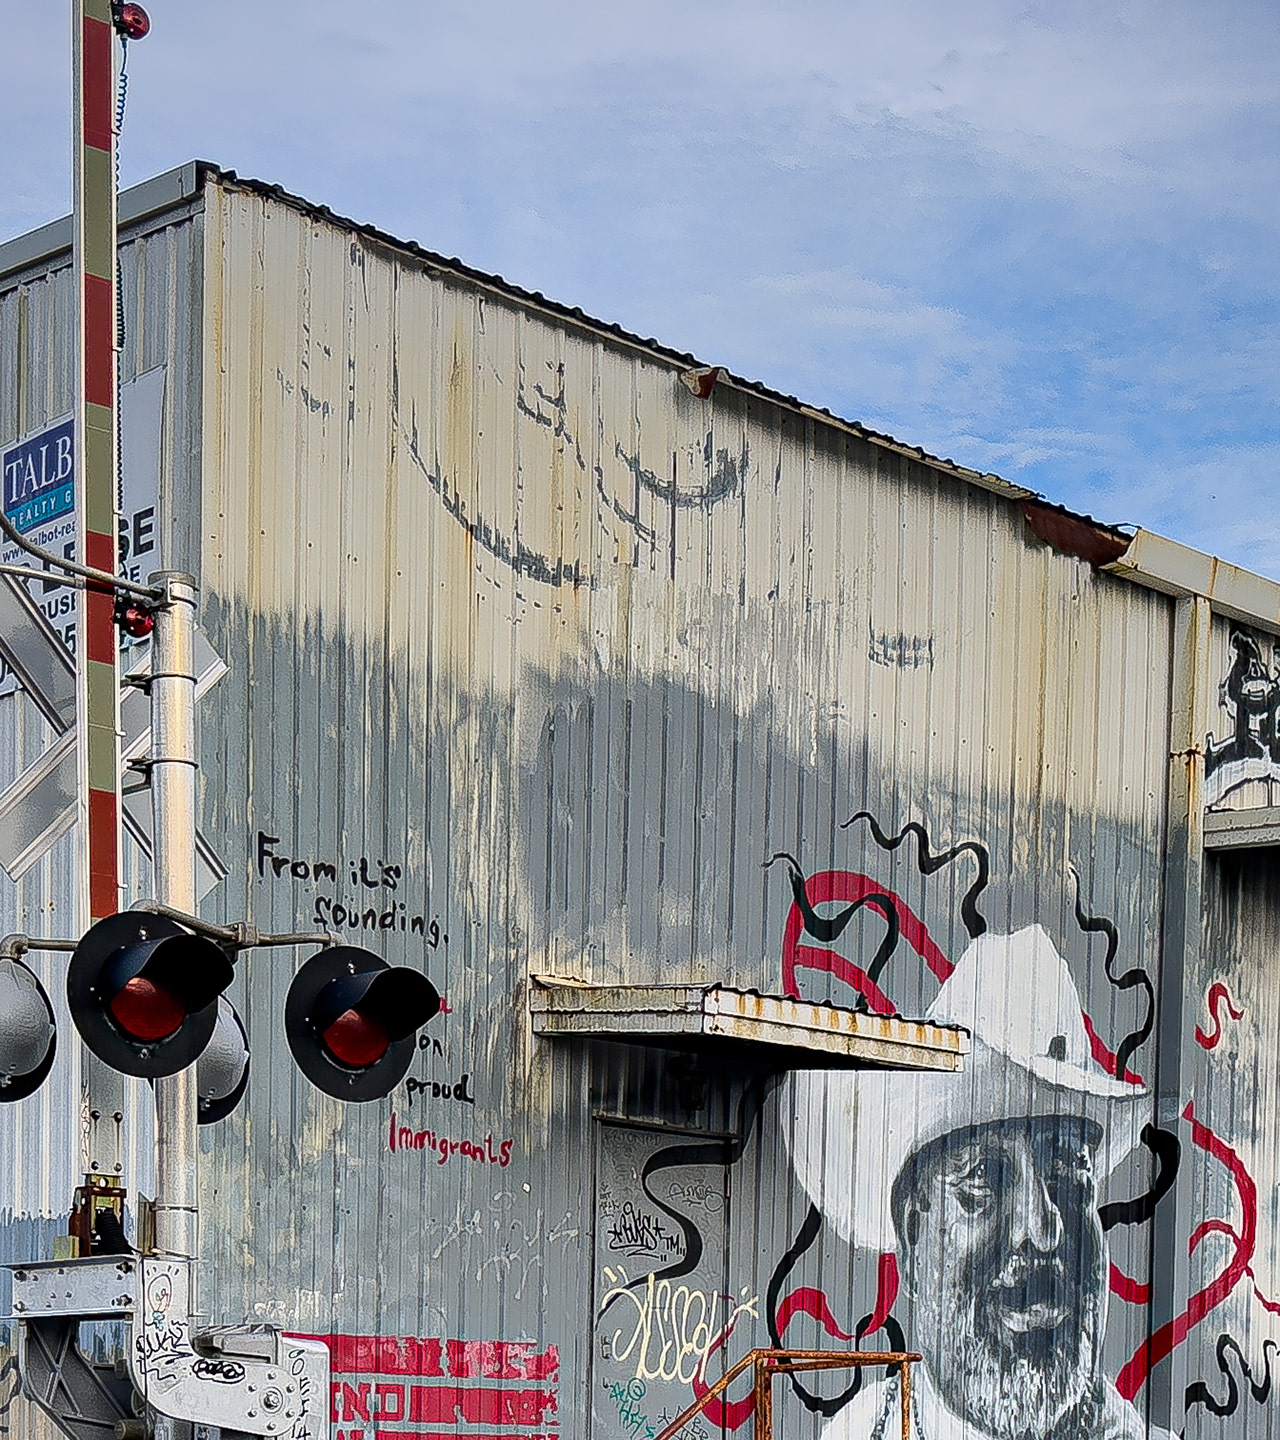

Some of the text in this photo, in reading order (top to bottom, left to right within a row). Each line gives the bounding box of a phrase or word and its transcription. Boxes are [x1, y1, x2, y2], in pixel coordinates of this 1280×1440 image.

[5, 435, 72, 504] TALB
[257, 831, 337, 882] From
[406, 1073, 475, 1107] proud
[389, 1112, 513, 1167] Immigrants
